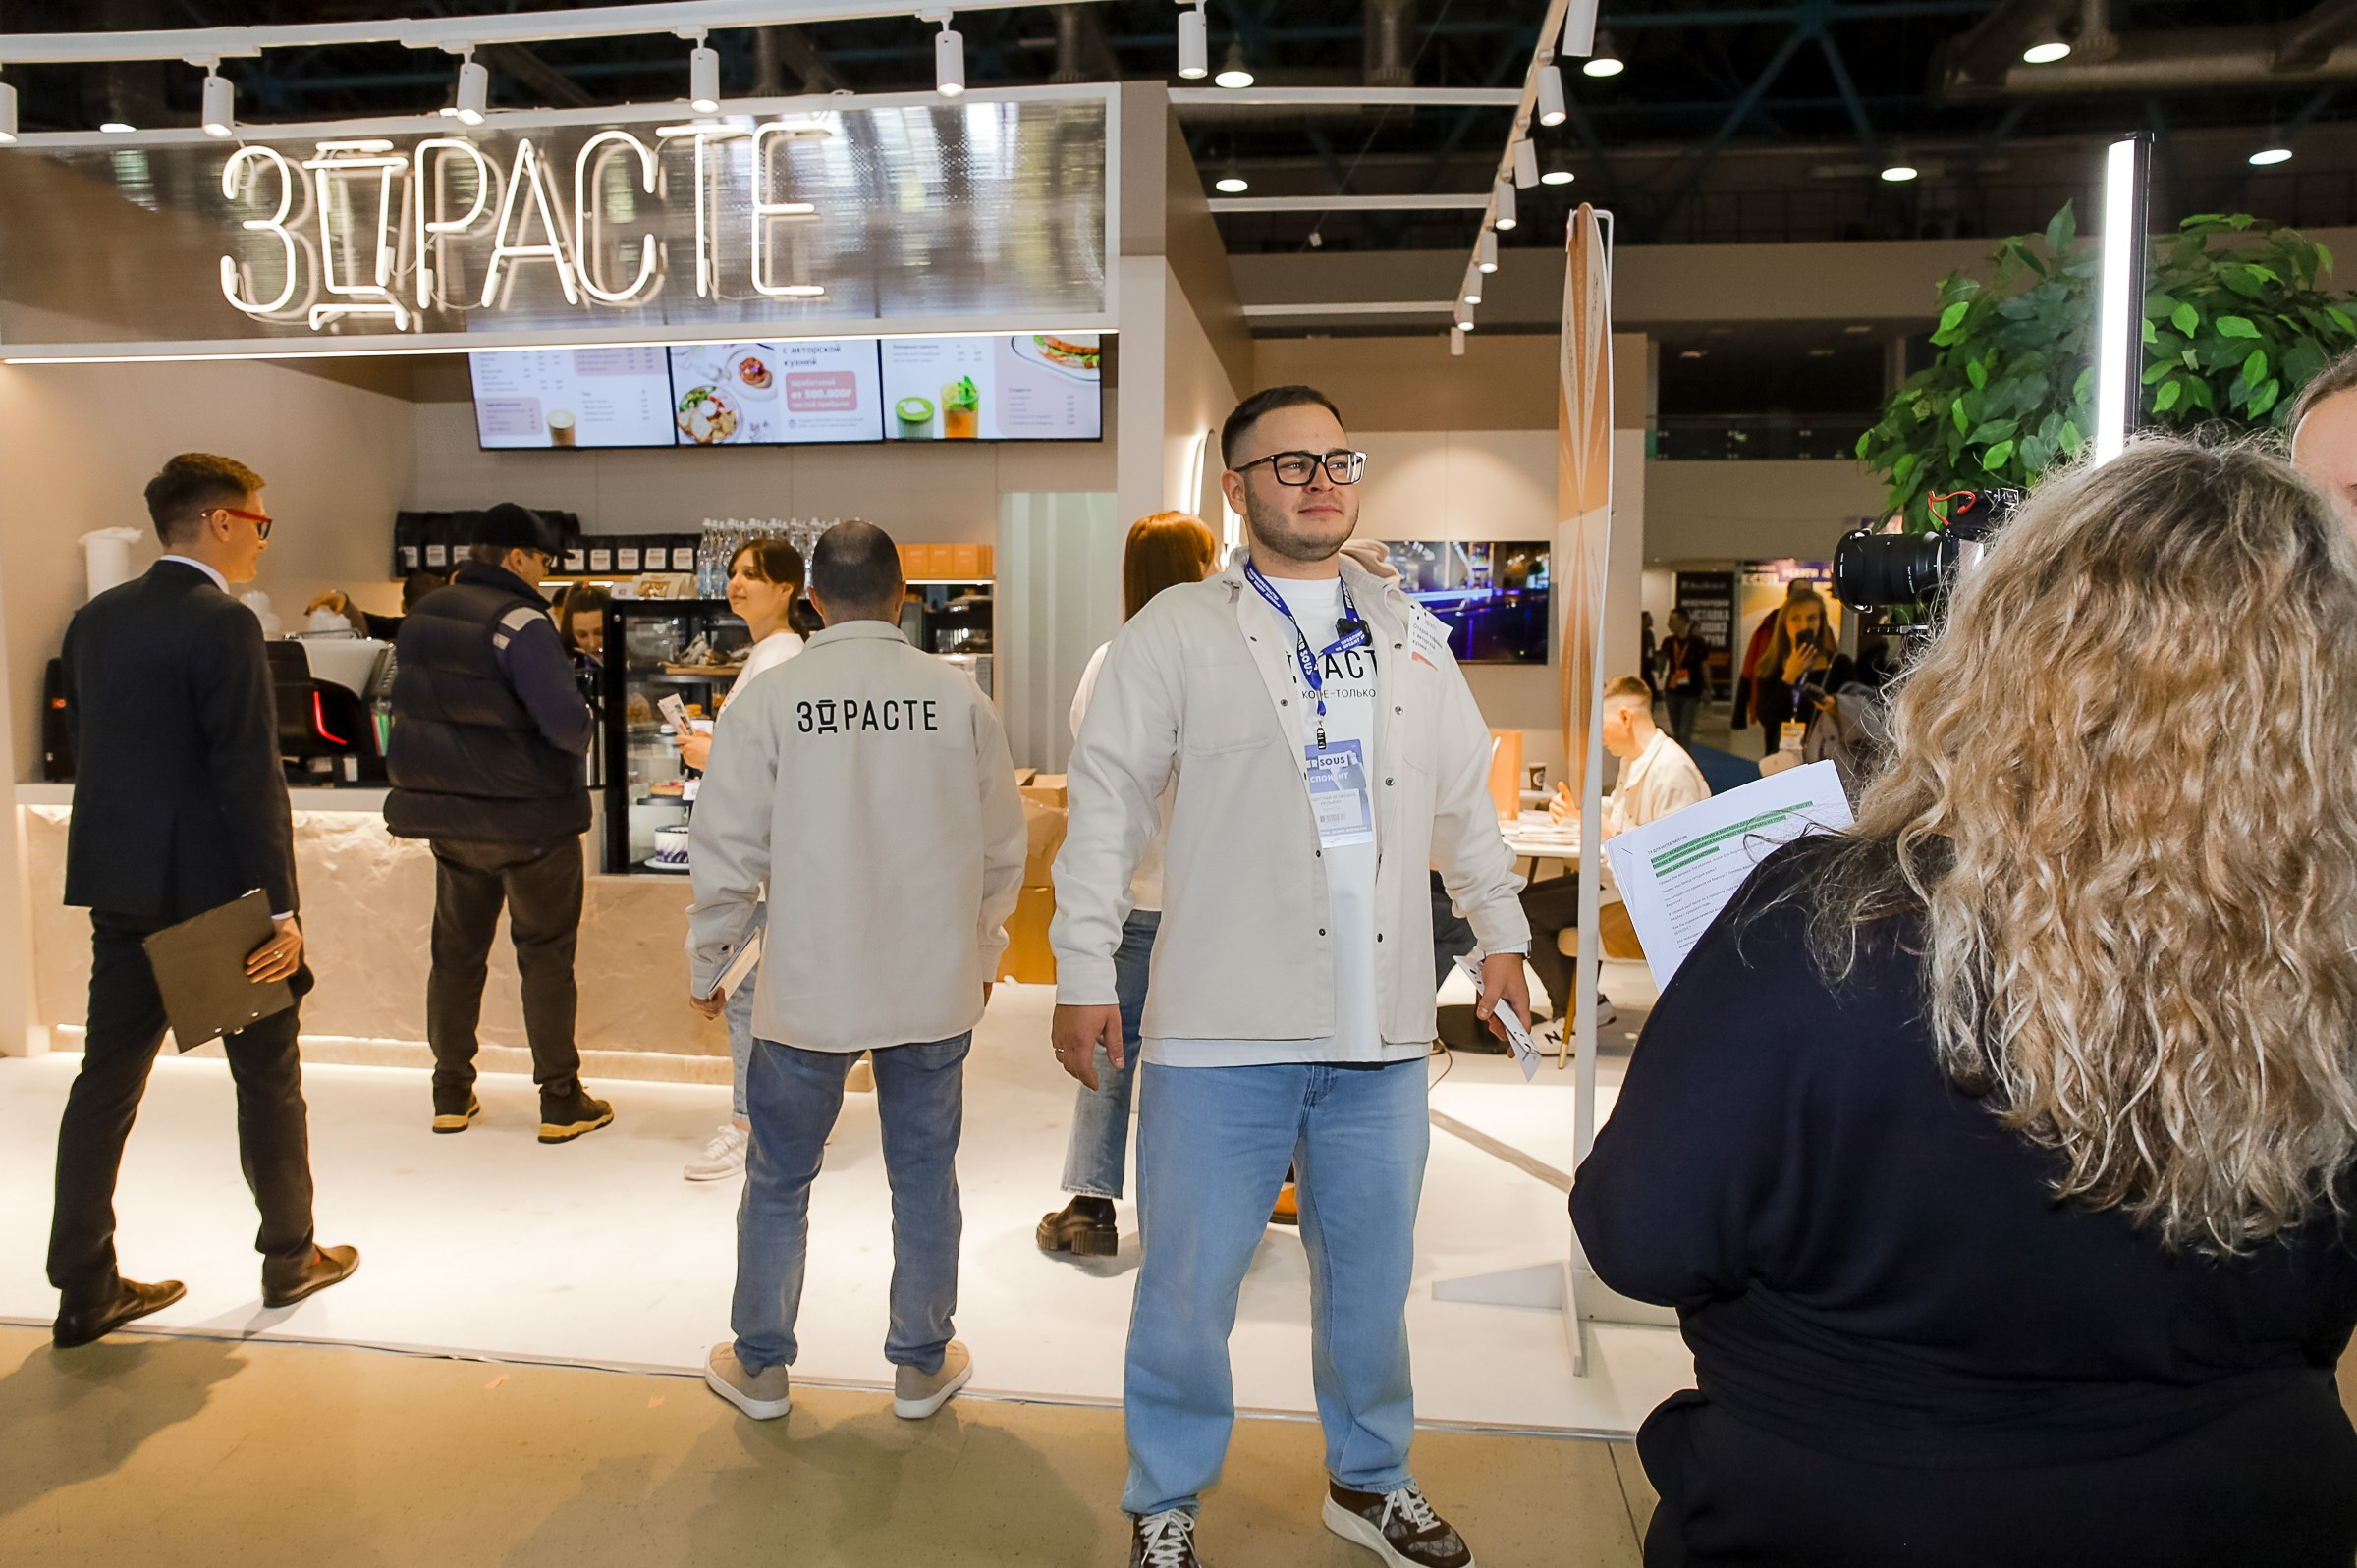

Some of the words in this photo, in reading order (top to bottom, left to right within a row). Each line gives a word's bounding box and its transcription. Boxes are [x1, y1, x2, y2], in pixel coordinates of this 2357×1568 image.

[221, 121, 833, 332] ЗДРАСТЕ
[796, 699, 938, 735] ЗДРАСТЕ
[1319, 756, 1345, 766] SOUS
